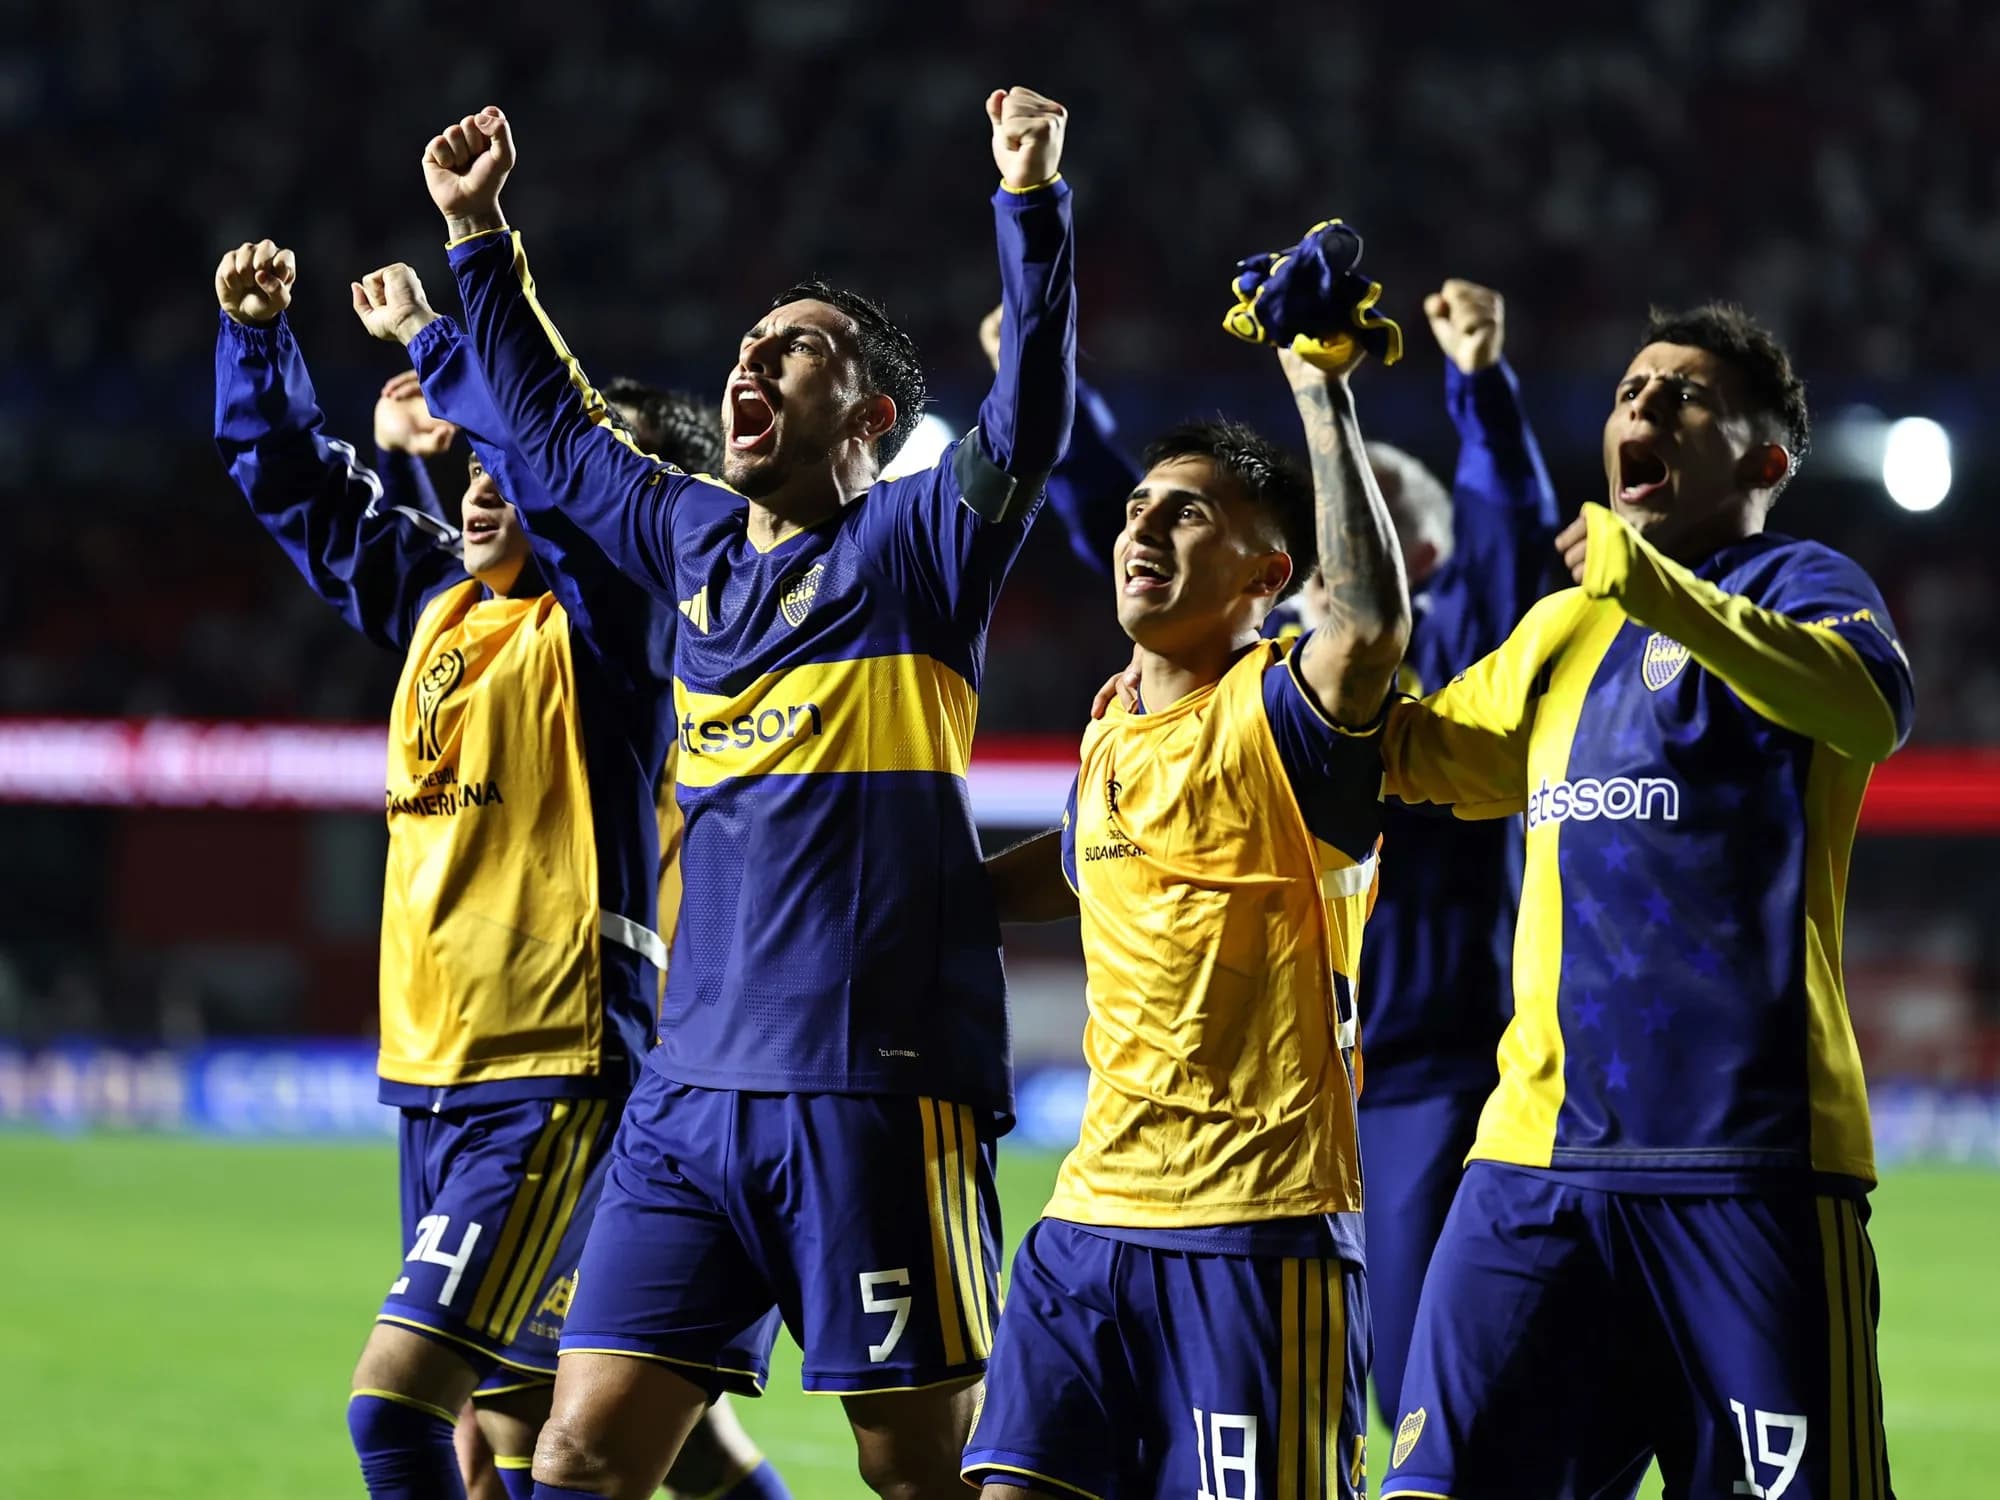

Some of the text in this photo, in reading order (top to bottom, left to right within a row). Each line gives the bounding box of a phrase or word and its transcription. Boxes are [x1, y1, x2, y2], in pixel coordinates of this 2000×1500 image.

[389, 1214, 483, 1307] 24
[859, 1267, 912, 1363] 5
[1192, 1407, 1258, 1500] 18
[1729, 1398, 1808, 1500] 19
